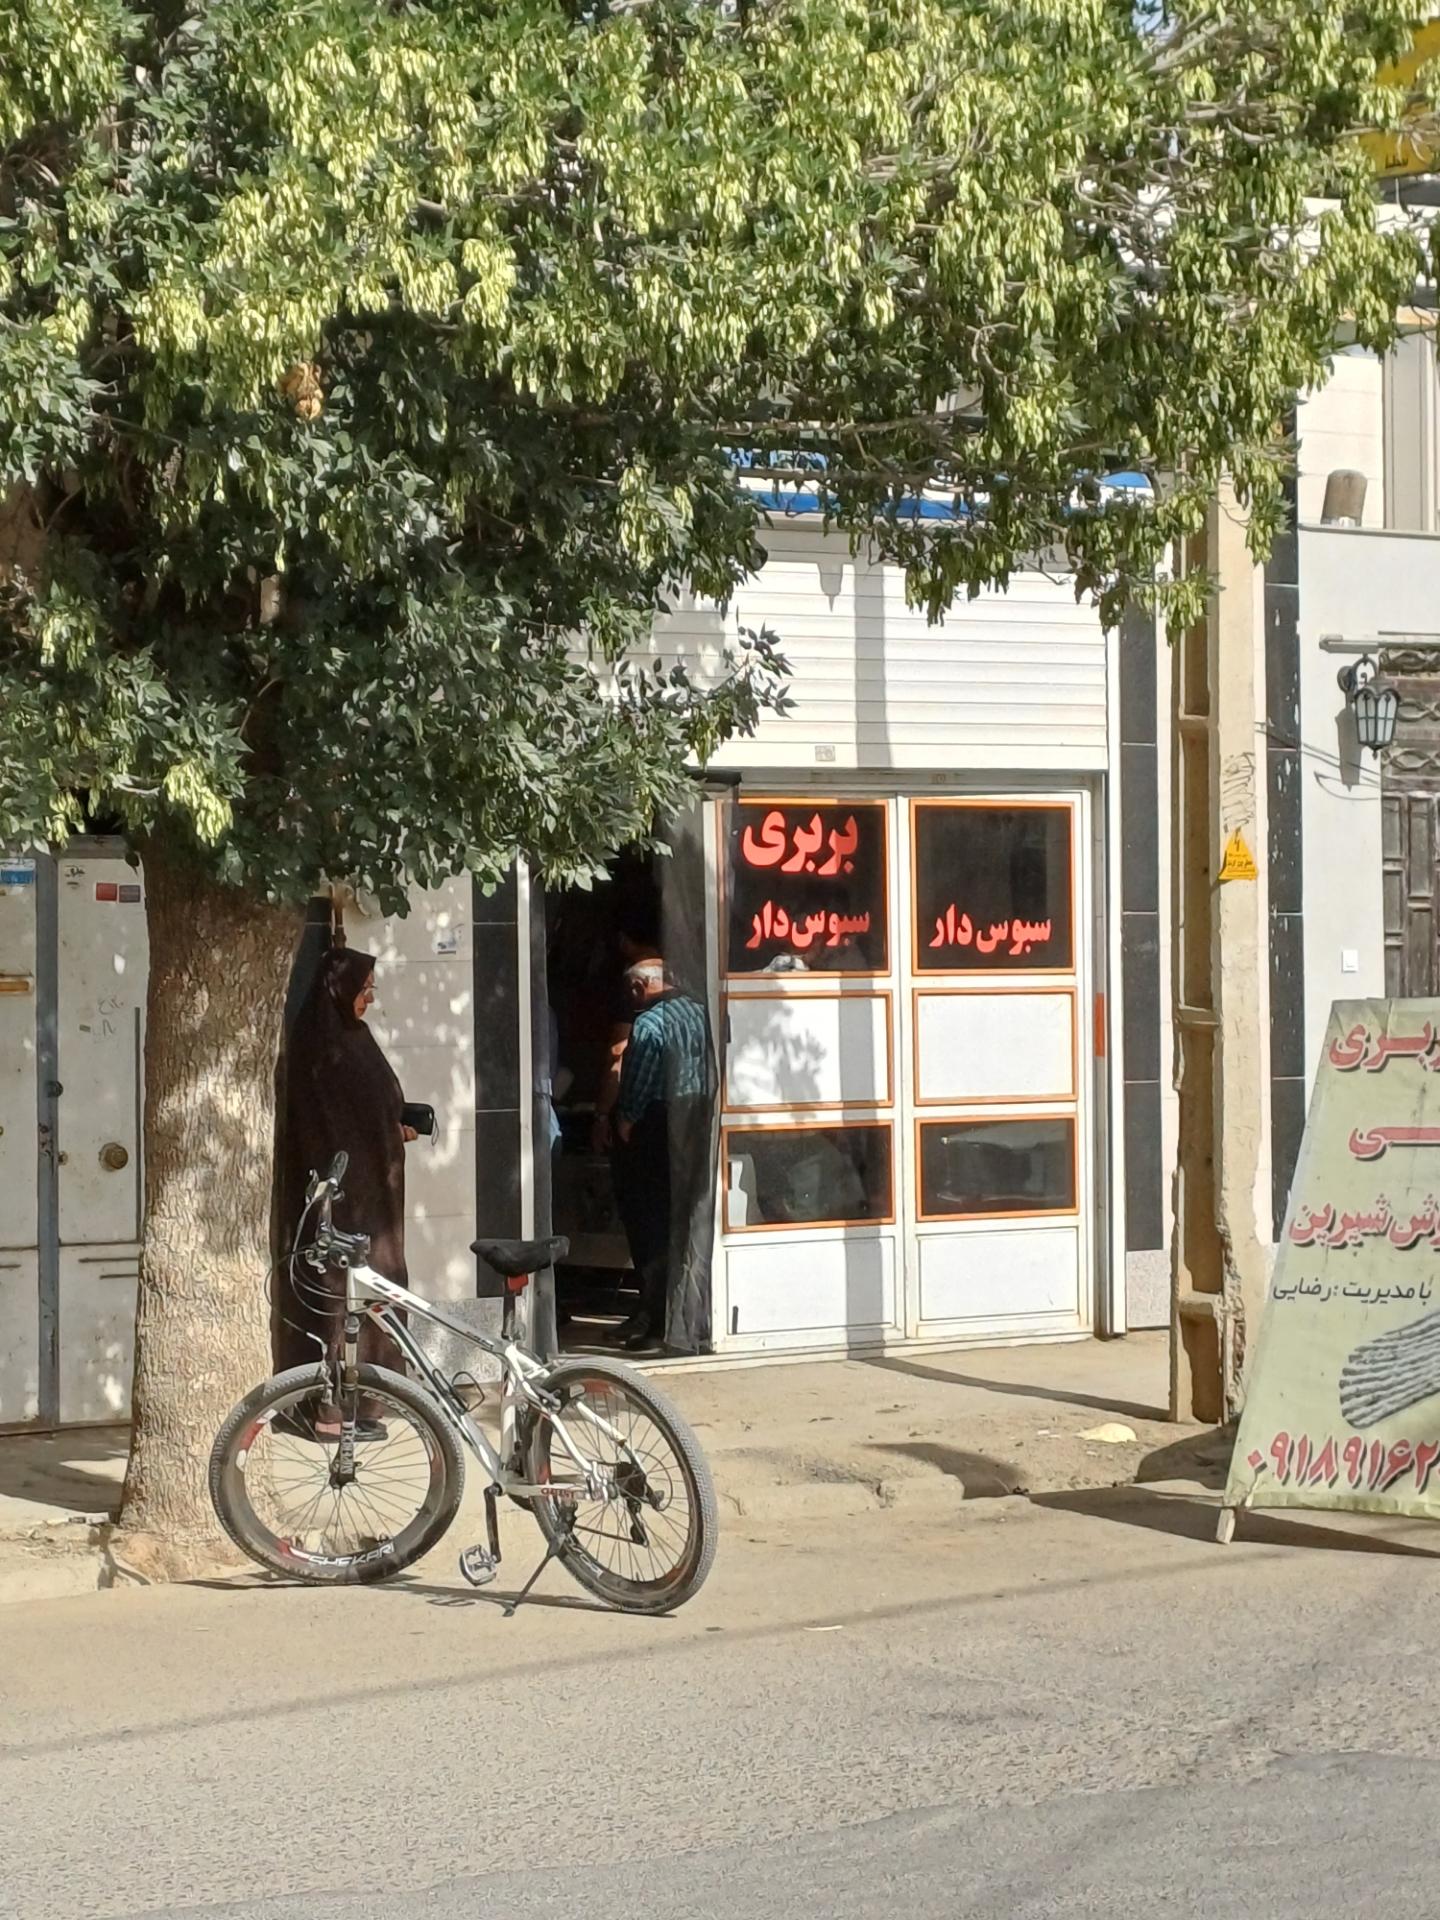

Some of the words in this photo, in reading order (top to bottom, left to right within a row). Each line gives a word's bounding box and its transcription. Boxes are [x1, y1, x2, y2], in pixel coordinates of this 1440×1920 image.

[742, 810, 858, 876] بربری
[746, 900, 793, 948] دار
[791, 909, 870, 948] سبوس
[929, 903, 973, 948] دار
[975, 918, 1052, 956] سبوس
[1289, 1193, 1388, 1248] شیرین
[1273, 1277, 1332, 1303] رضایی
[1247, 1431, 1440, 1490] ۰۹۱۸۹۱۶۲
